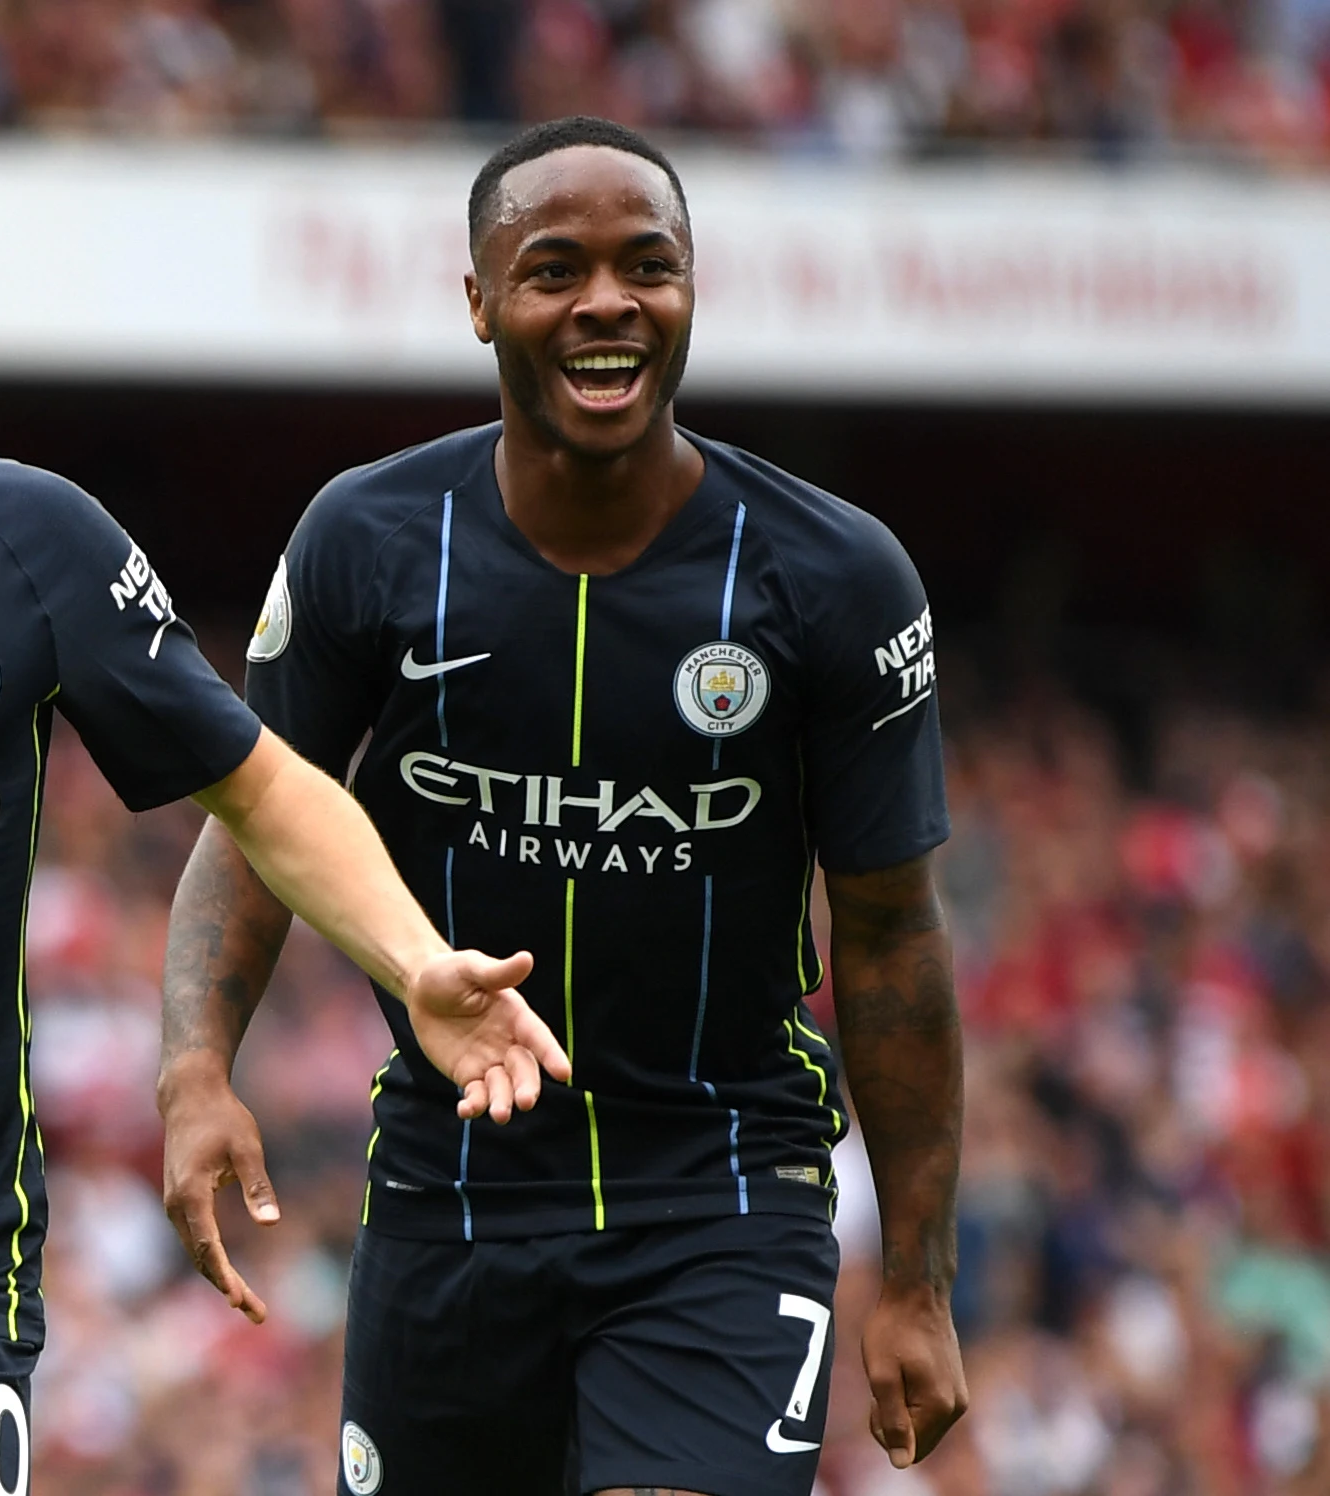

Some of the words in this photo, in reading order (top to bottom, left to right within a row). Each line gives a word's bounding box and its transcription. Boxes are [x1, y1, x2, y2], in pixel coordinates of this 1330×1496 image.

[685, 648, 762, 676] MANCHESTER
[707, 721, 735, 730] CITY
[399, 751, 762, 833] ETIHAD
[468, 821, 692, 874] AIRWAYS
[778, 1293, 831, 1422] 7
